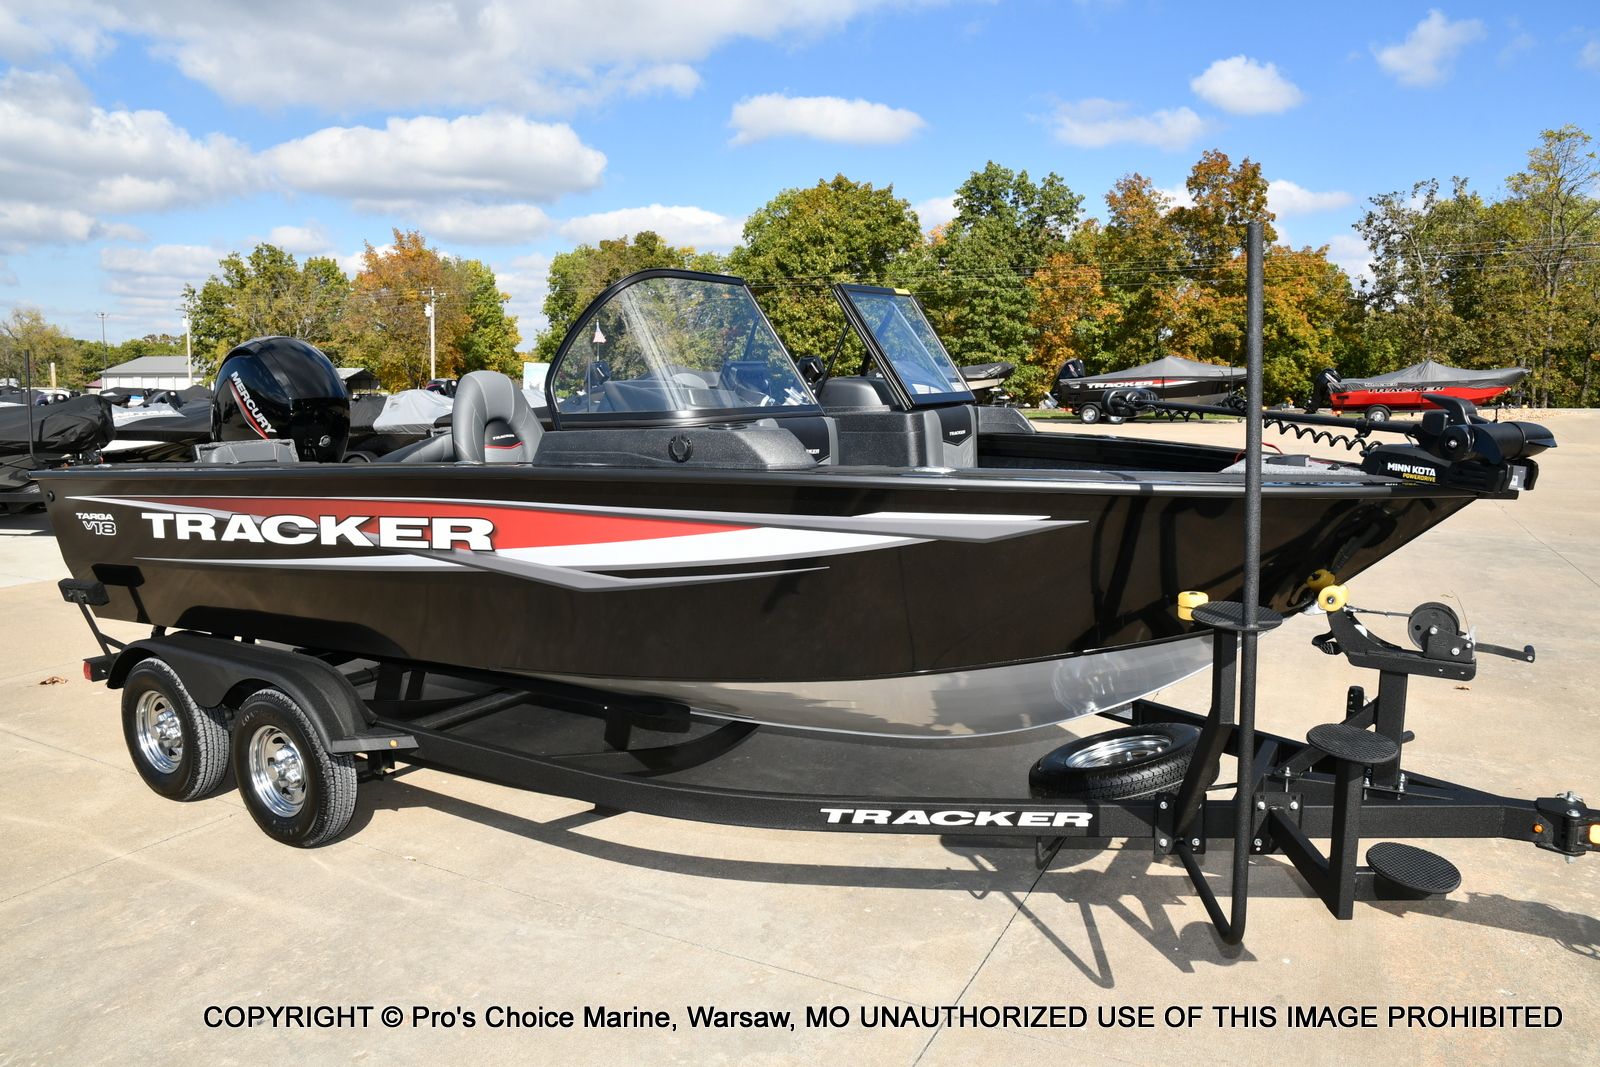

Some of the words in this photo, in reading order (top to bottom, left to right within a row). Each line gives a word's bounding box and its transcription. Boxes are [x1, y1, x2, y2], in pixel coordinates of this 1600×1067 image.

[1086, 380, 1154, 390] TRACKER
[1367, 386, 1446, 394] TRACKER
[231, 370, 278, 433] MERCURY
[1387, 462, 1411, 473] MINN
[1411, 465, 1436, 477] KOTA
[1402, 472, 1436, 483] POWERDRIVE
[75, 512, 114, 521] TARGA
[82, 520, 117, 536] V18
[140, 511, 496, 552] TRACKER
[819, 808, 1094, 828] TRACKER
